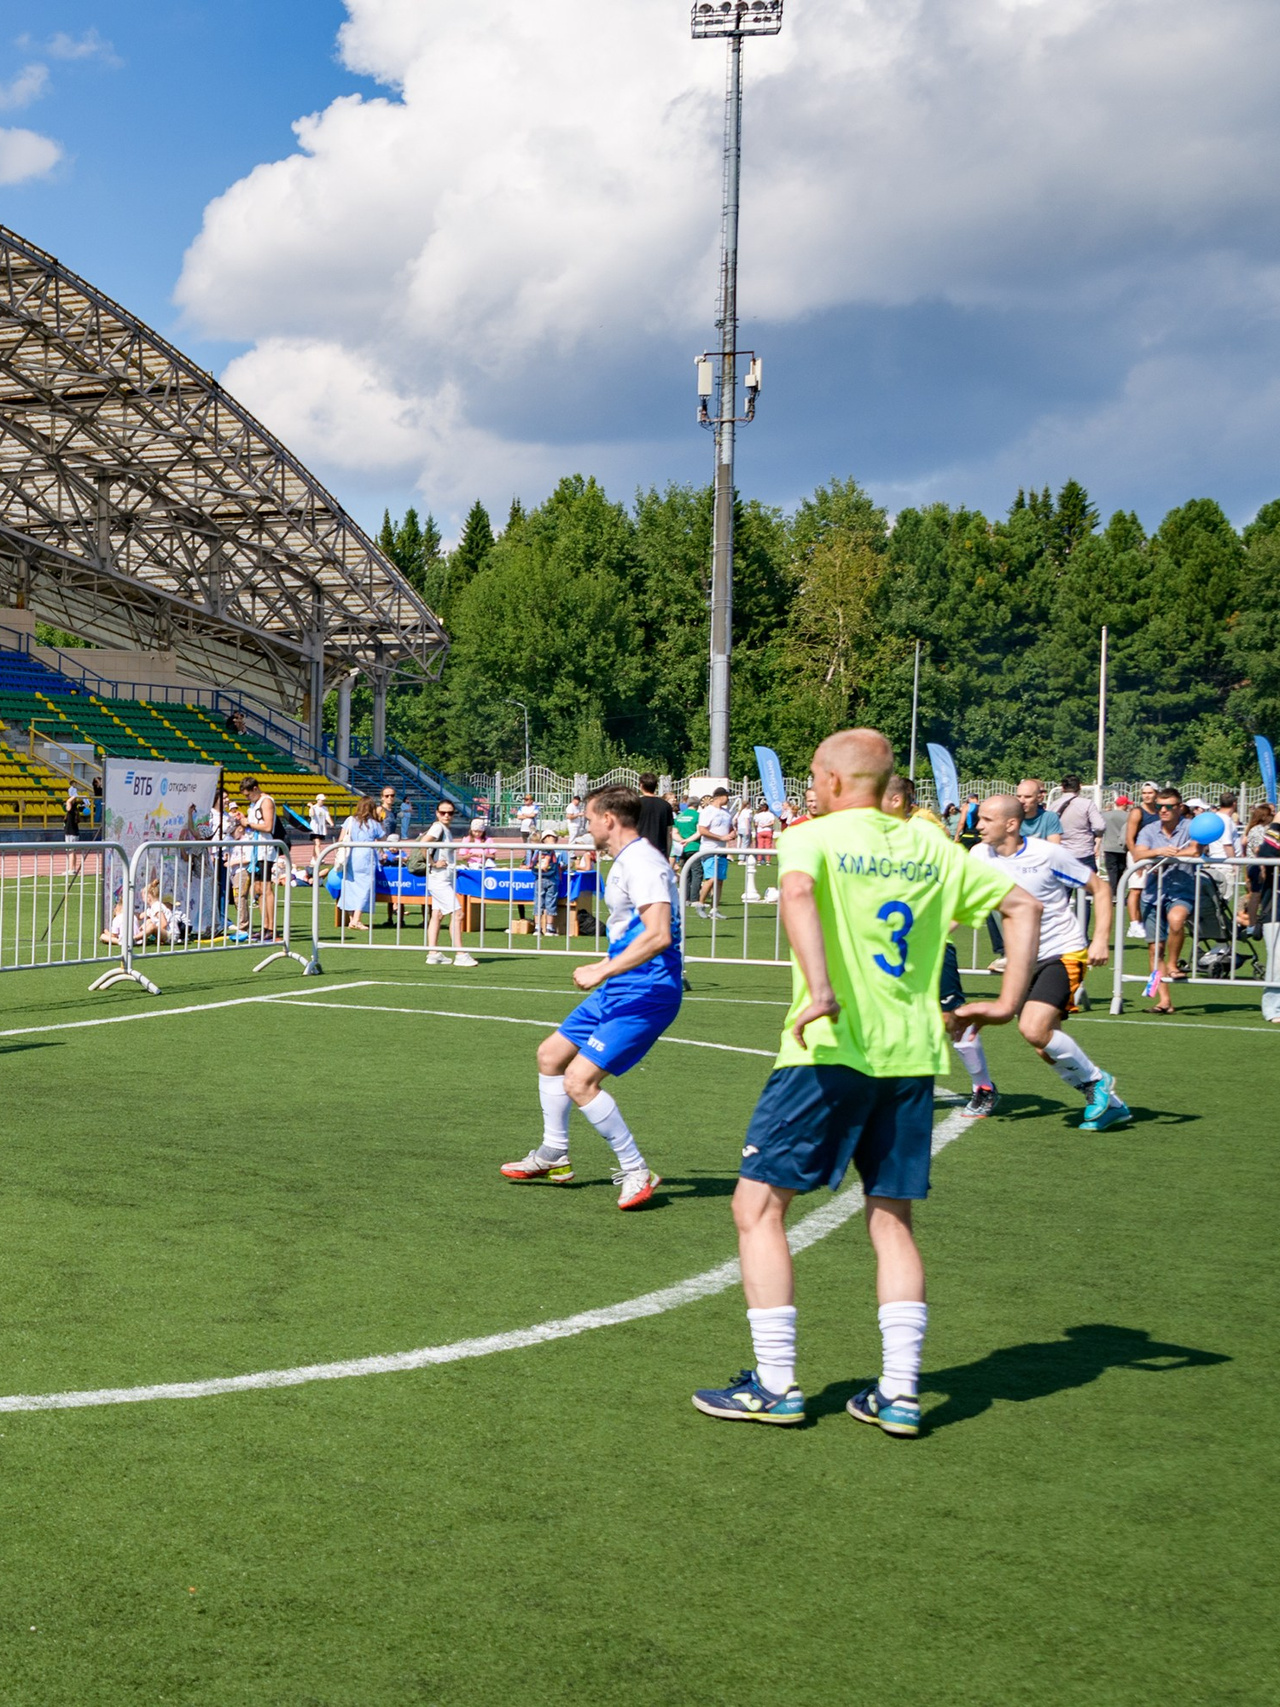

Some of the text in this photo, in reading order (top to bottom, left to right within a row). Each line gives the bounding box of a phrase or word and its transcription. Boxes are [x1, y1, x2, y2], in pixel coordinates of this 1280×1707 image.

[133, 776, 153, 796] ВТБ
[498, 880, 534, 891] открыт
[873, 900, 913, 978] 3
